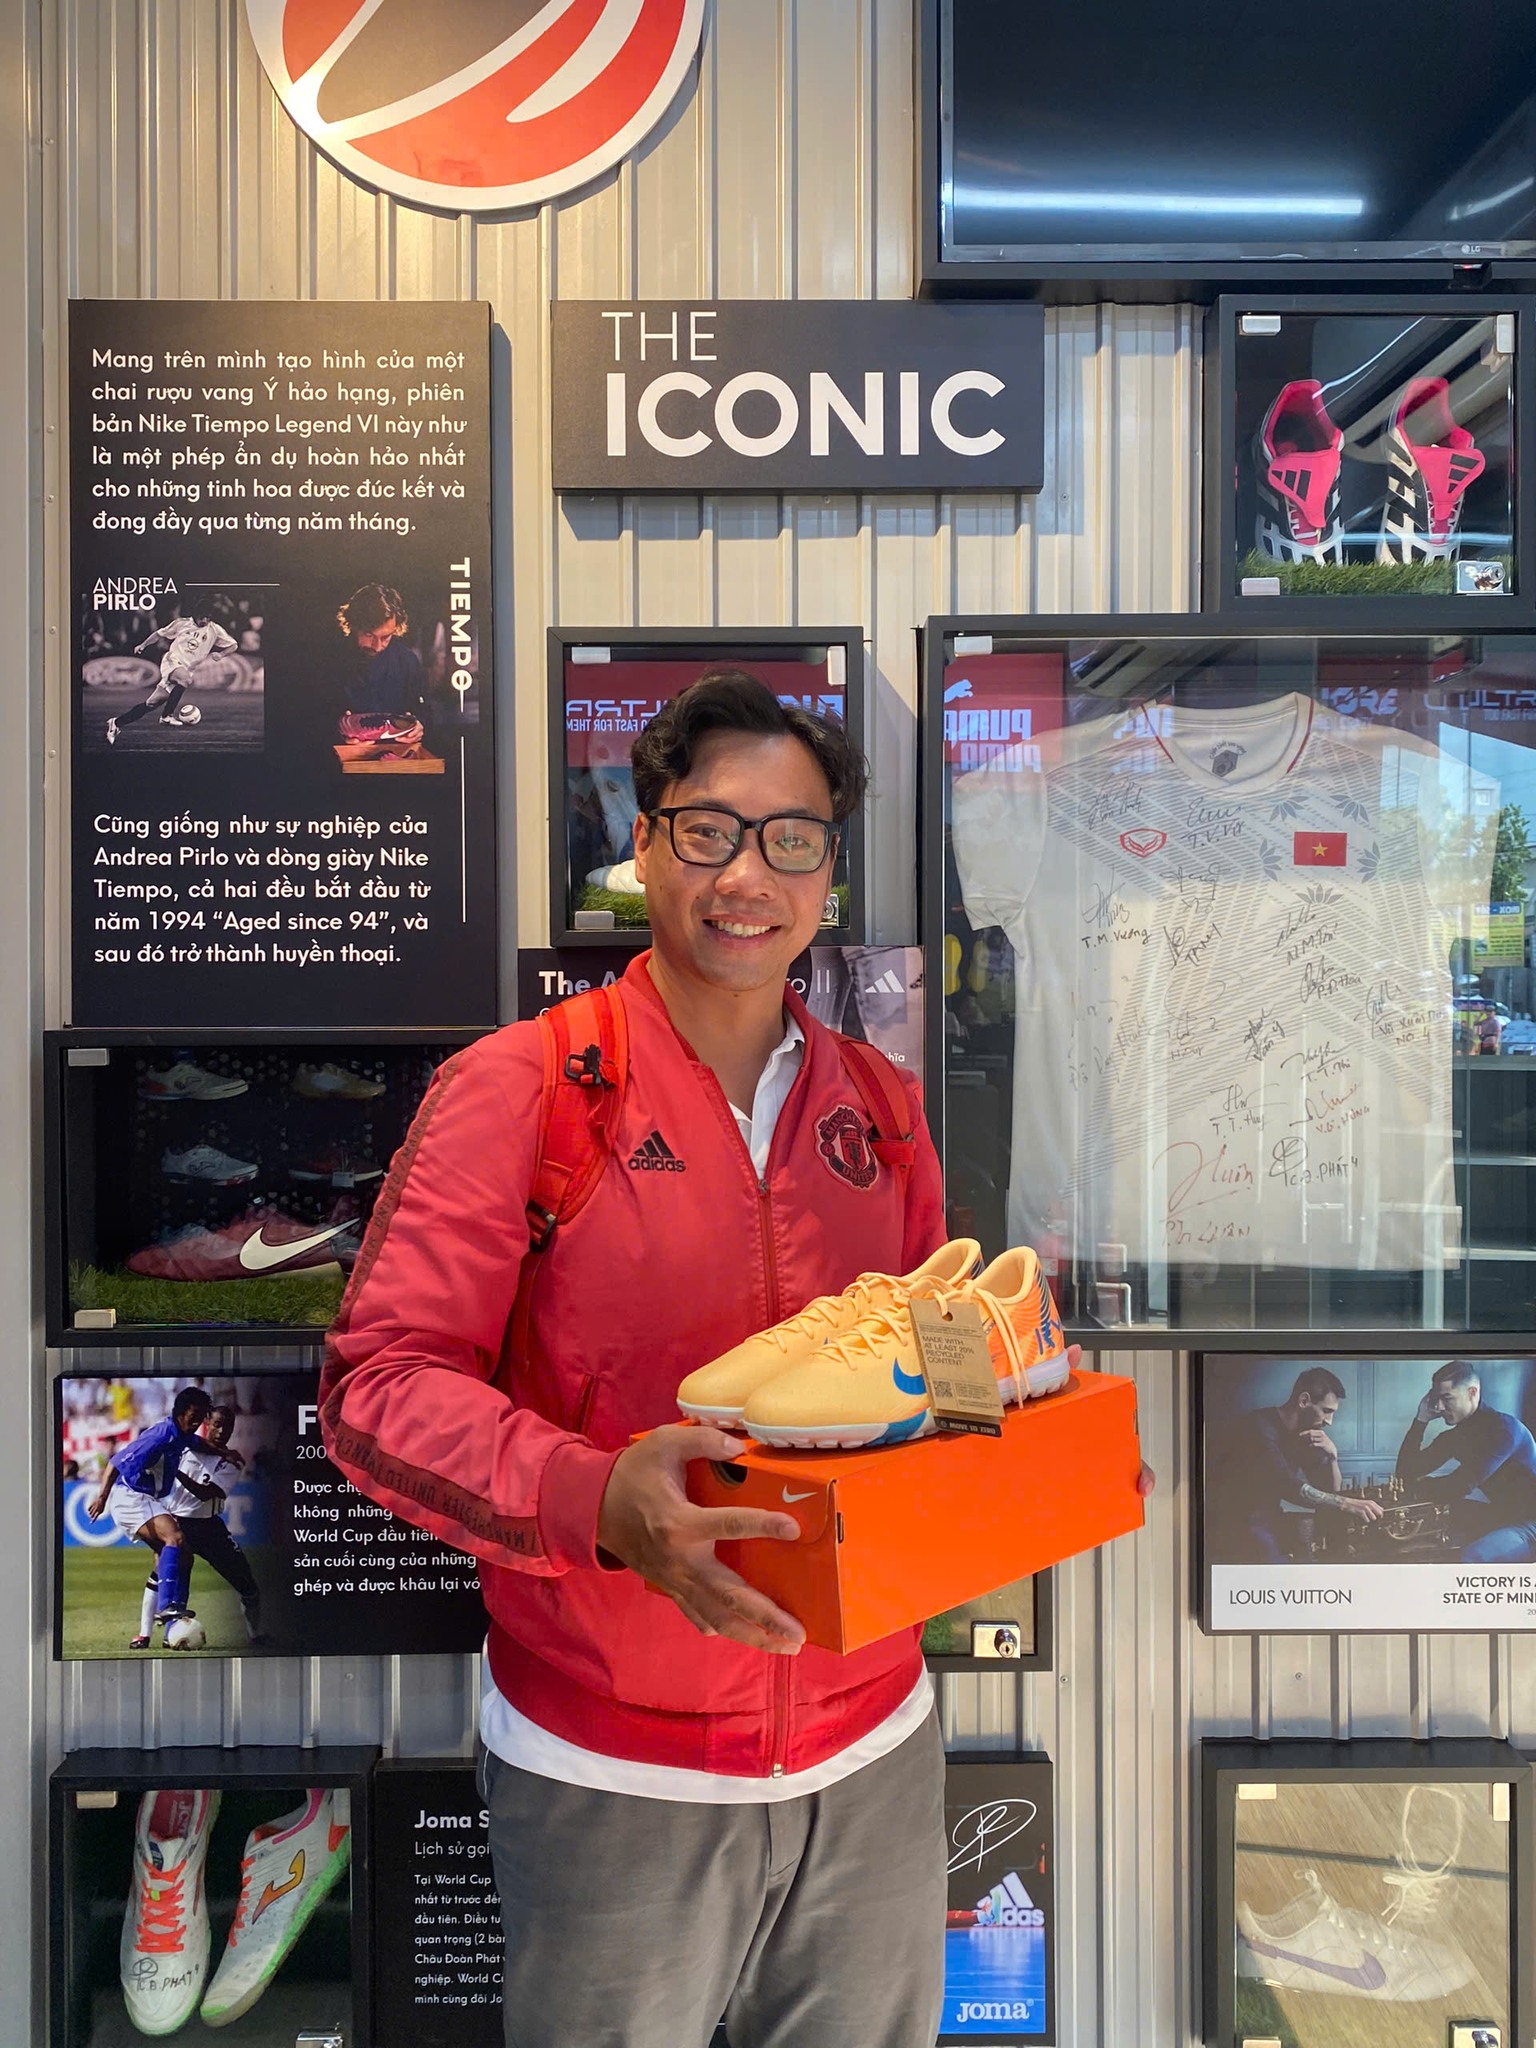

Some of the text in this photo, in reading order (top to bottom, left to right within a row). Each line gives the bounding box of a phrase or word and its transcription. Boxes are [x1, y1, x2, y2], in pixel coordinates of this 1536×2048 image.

[1471, 245, 1481, 253] LG
[602, 312, 716, 360] THE
[93, 349, 465, 373] Mang trên mình tạo hình của một
[92, 376, 464, 406] chai rượu vang Ý hảo hạng, phiên
[93, 413, 467, 438] bản Nike Tiempo Legend VI này như
[607, 371, 1005, 457] ICONIC
[94, 441, 466, 470] là một phép ẩn dụ hoàn hảo nhất
[93, 475, 464, 502] cho những tinh hoa được đúc kết và
[93, 506, 415, 535] đong đầy qua từng năm tháng.
[93, 578, 177, 593] ANDREA
[94, 594, 155, 610] PIRLO
[450, 557, 474, 692] TIEMPO
[93, 809, 428, 840] Cũng giống như sự nghiệp của
[93, 846, 429, 872] Andrea Pirlo và dòng giày Nike
[93, 874, 432, 904] Tiempo, cả hai đều bắt đầu từ
[95, 910, 429, 936] năm 1994 “Aged since 94”, và
[94, 938, 401, 968] sau đó trở thành huyền thoại.
[539, 971, 591, 995] The
[628, 1156, 686, 1173] adidas
[293, 1479, 332, 1497] Được
[294, 1503, 393, 1522] không những
[293, 1525, 406, 1546] World Cup đầu
[293, 1549, 477, 1570] sản cuối cùng của những
[293, 1578, 333, 1597] ghép
[335, 1578, 354, 1592] và
[358, 1577, 396, 1595] được
[399, 1577, 436, 1591] khâu
[440, 1576, 459, 1593] lại
[1456, 1577, 1531, 1587] VICTORY IS
[1230, 1590, 1351, 1604] LOUIS VUITTON
[1443, 1593, 1536, 1603] STATE OF MIN
